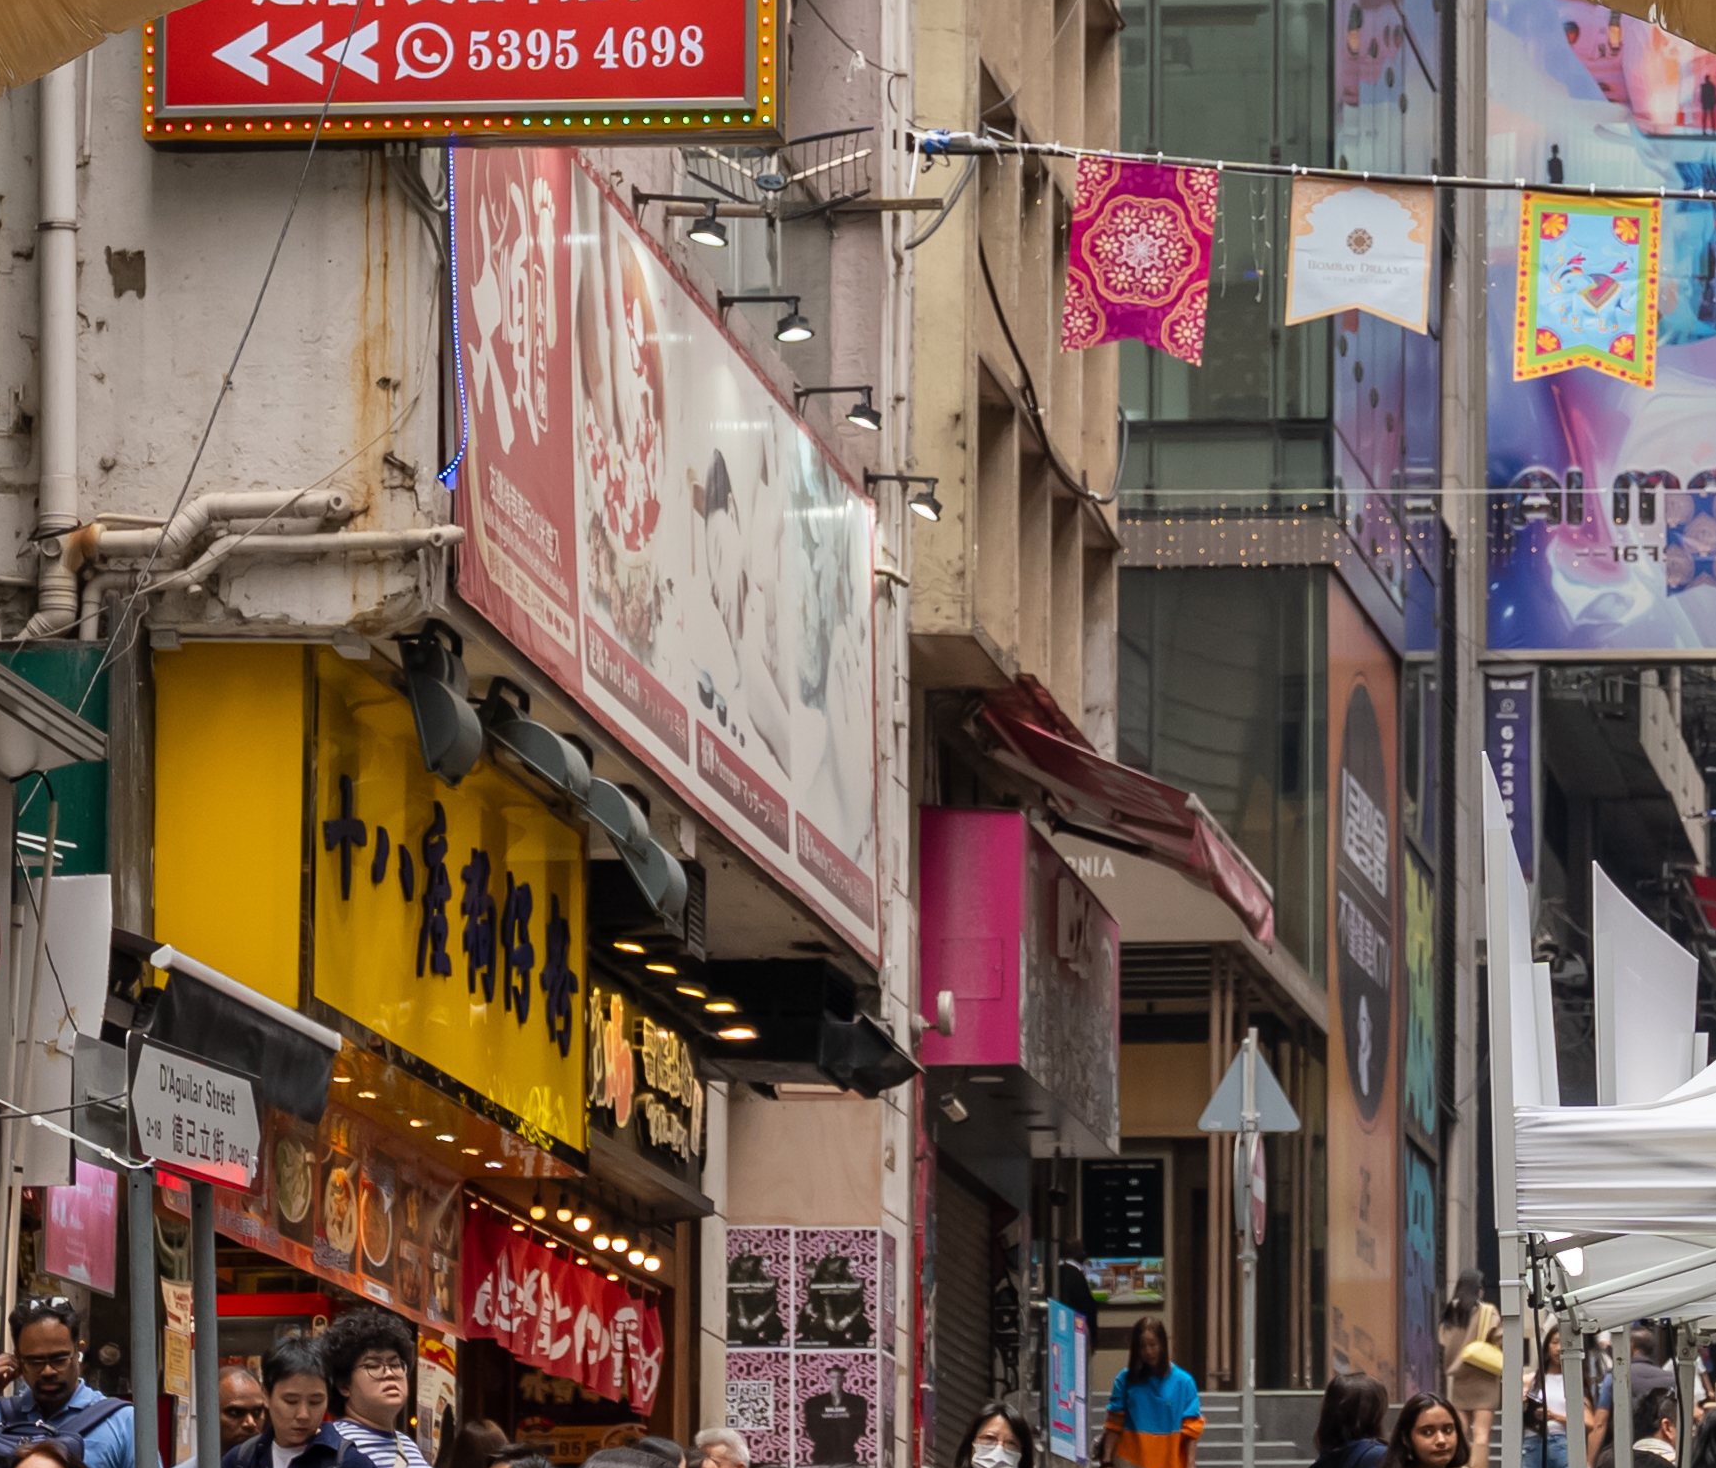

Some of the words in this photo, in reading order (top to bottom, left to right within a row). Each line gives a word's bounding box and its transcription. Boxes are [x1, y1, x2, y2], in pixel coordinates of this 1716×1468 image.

[467, 29, 580, 71] 5395
[593, 25, 704, 70] 4698
[159, 1062, 203, 1104] D'Aguilar
[205, 1079, 236, 1117] Street
